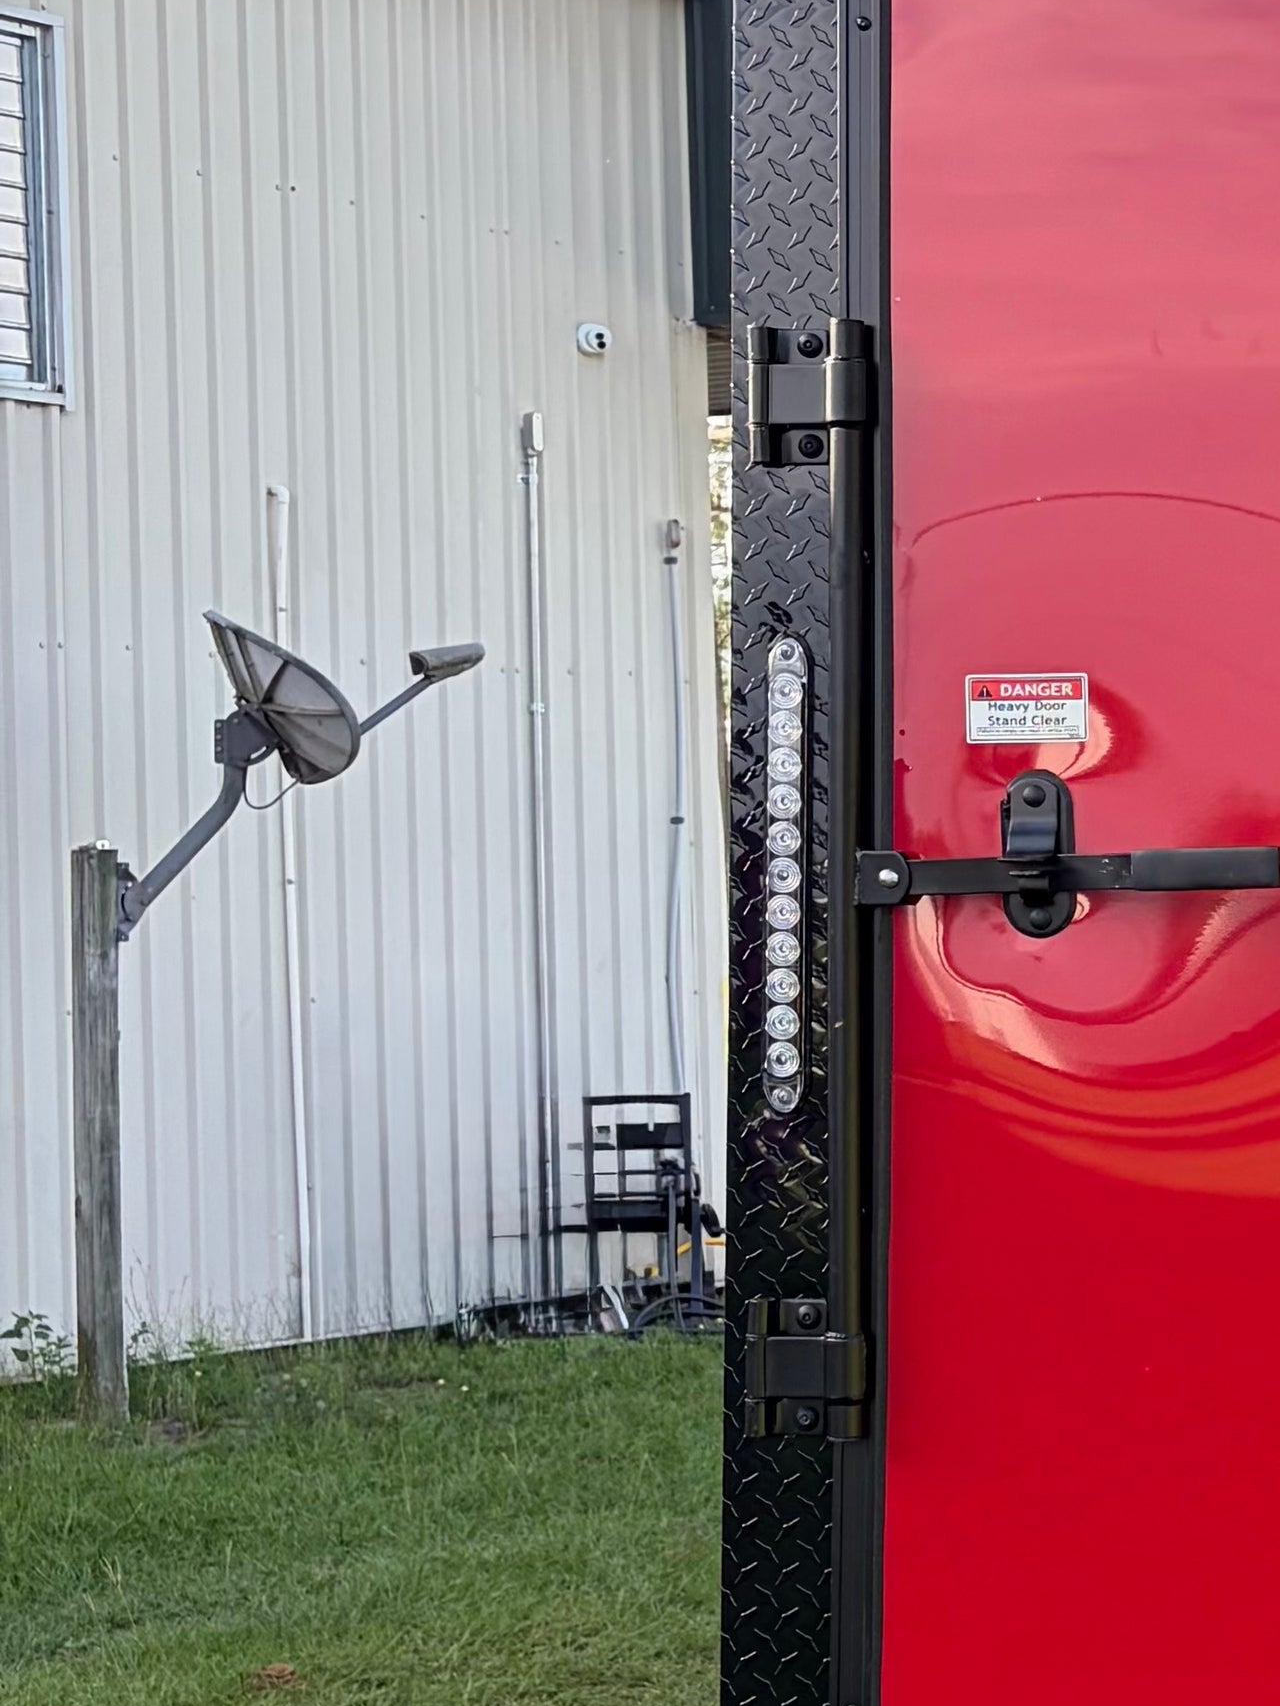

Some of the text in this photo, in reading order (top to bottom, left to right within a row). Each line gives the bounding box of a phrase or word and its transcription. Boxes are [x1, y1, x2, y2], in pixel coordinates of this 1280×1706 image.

[1000, 682, 1073, 697] DANGER
[988, 701, 1067, 713] Heavy Door
[988, 715, 1067, 726] Stand Clear
